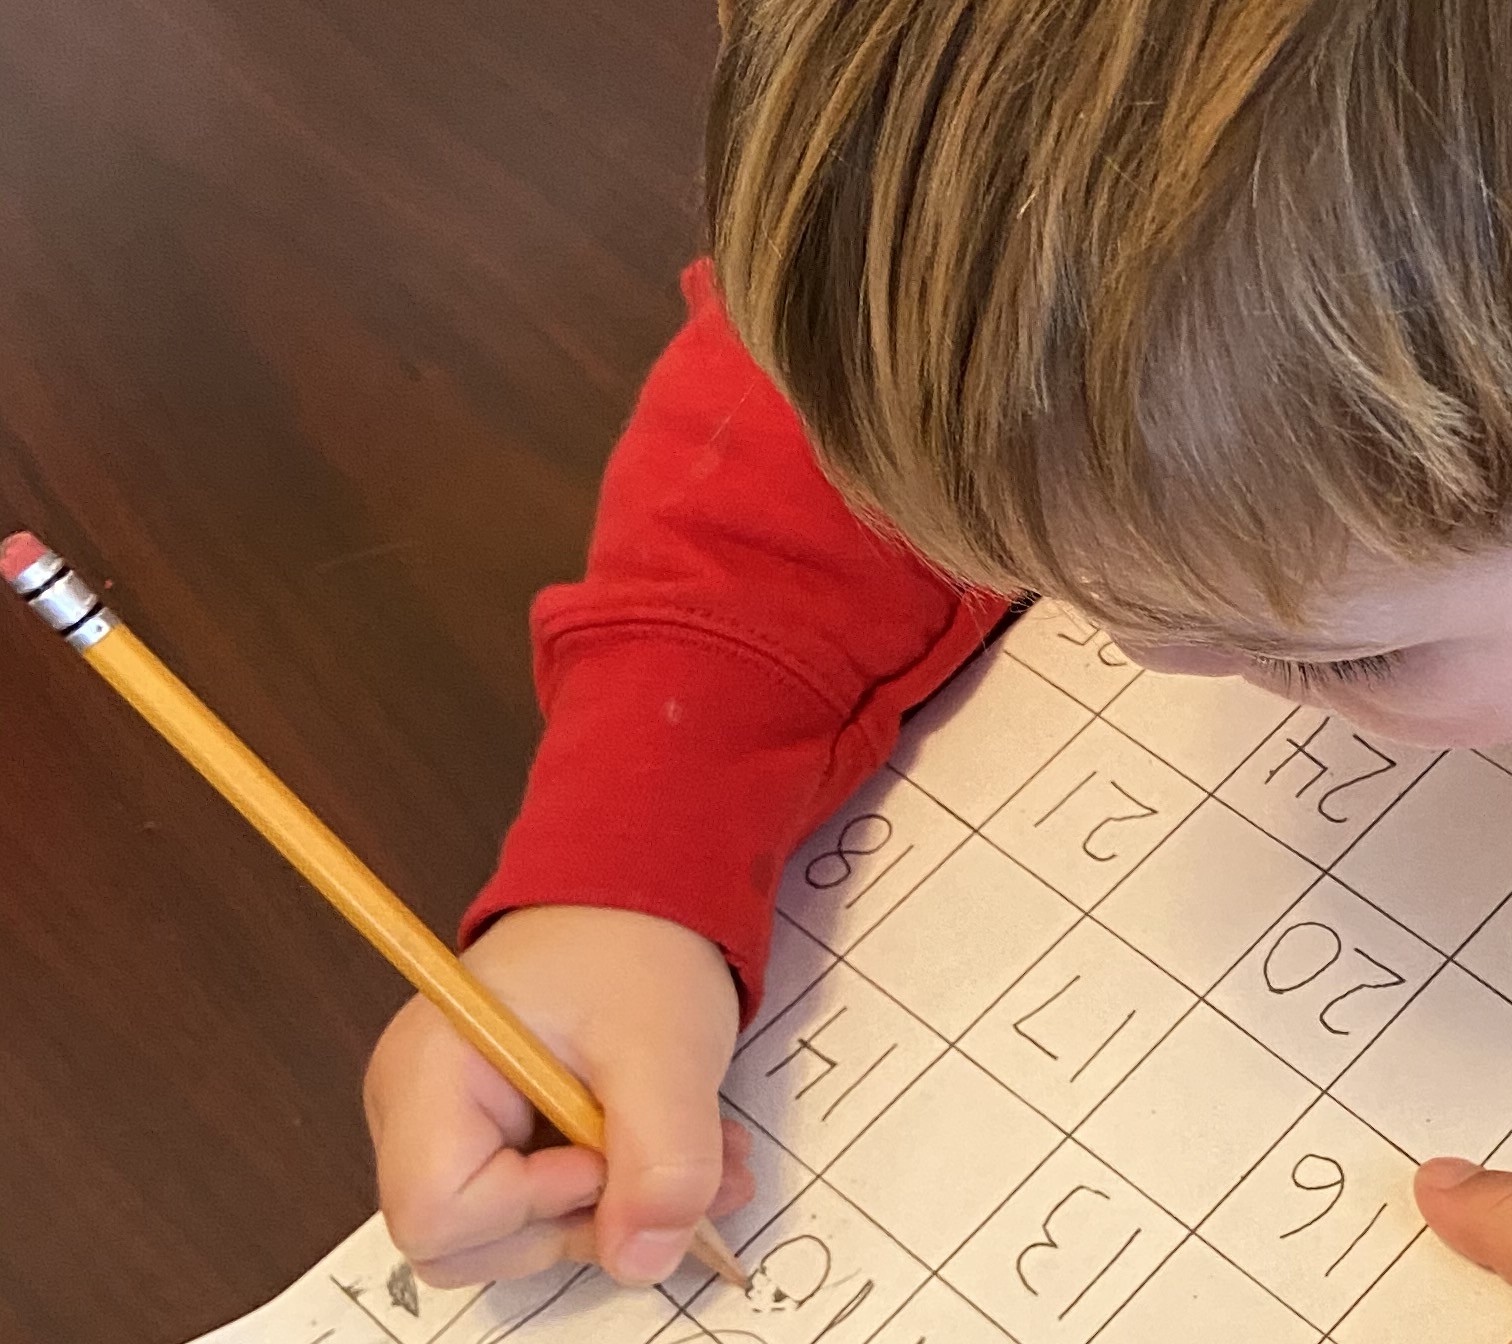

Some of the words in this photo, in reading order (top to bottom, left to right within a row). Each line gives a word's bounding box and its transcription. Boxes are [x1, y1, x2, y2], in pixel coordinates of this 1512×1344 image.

[1033, 770, 1159, 863] 21
[1264, 715, 1398, 824] 24
[804, 812, 915, 910] 18
[1012, 974, 1137, 1084] 17
[1262, 921, 1408, 1037] 20
[764, 1006, 899, 1122] 14
[1015, 1184, 1143, 1321] 13
[1279, 1153, 1389, 1278] 16
